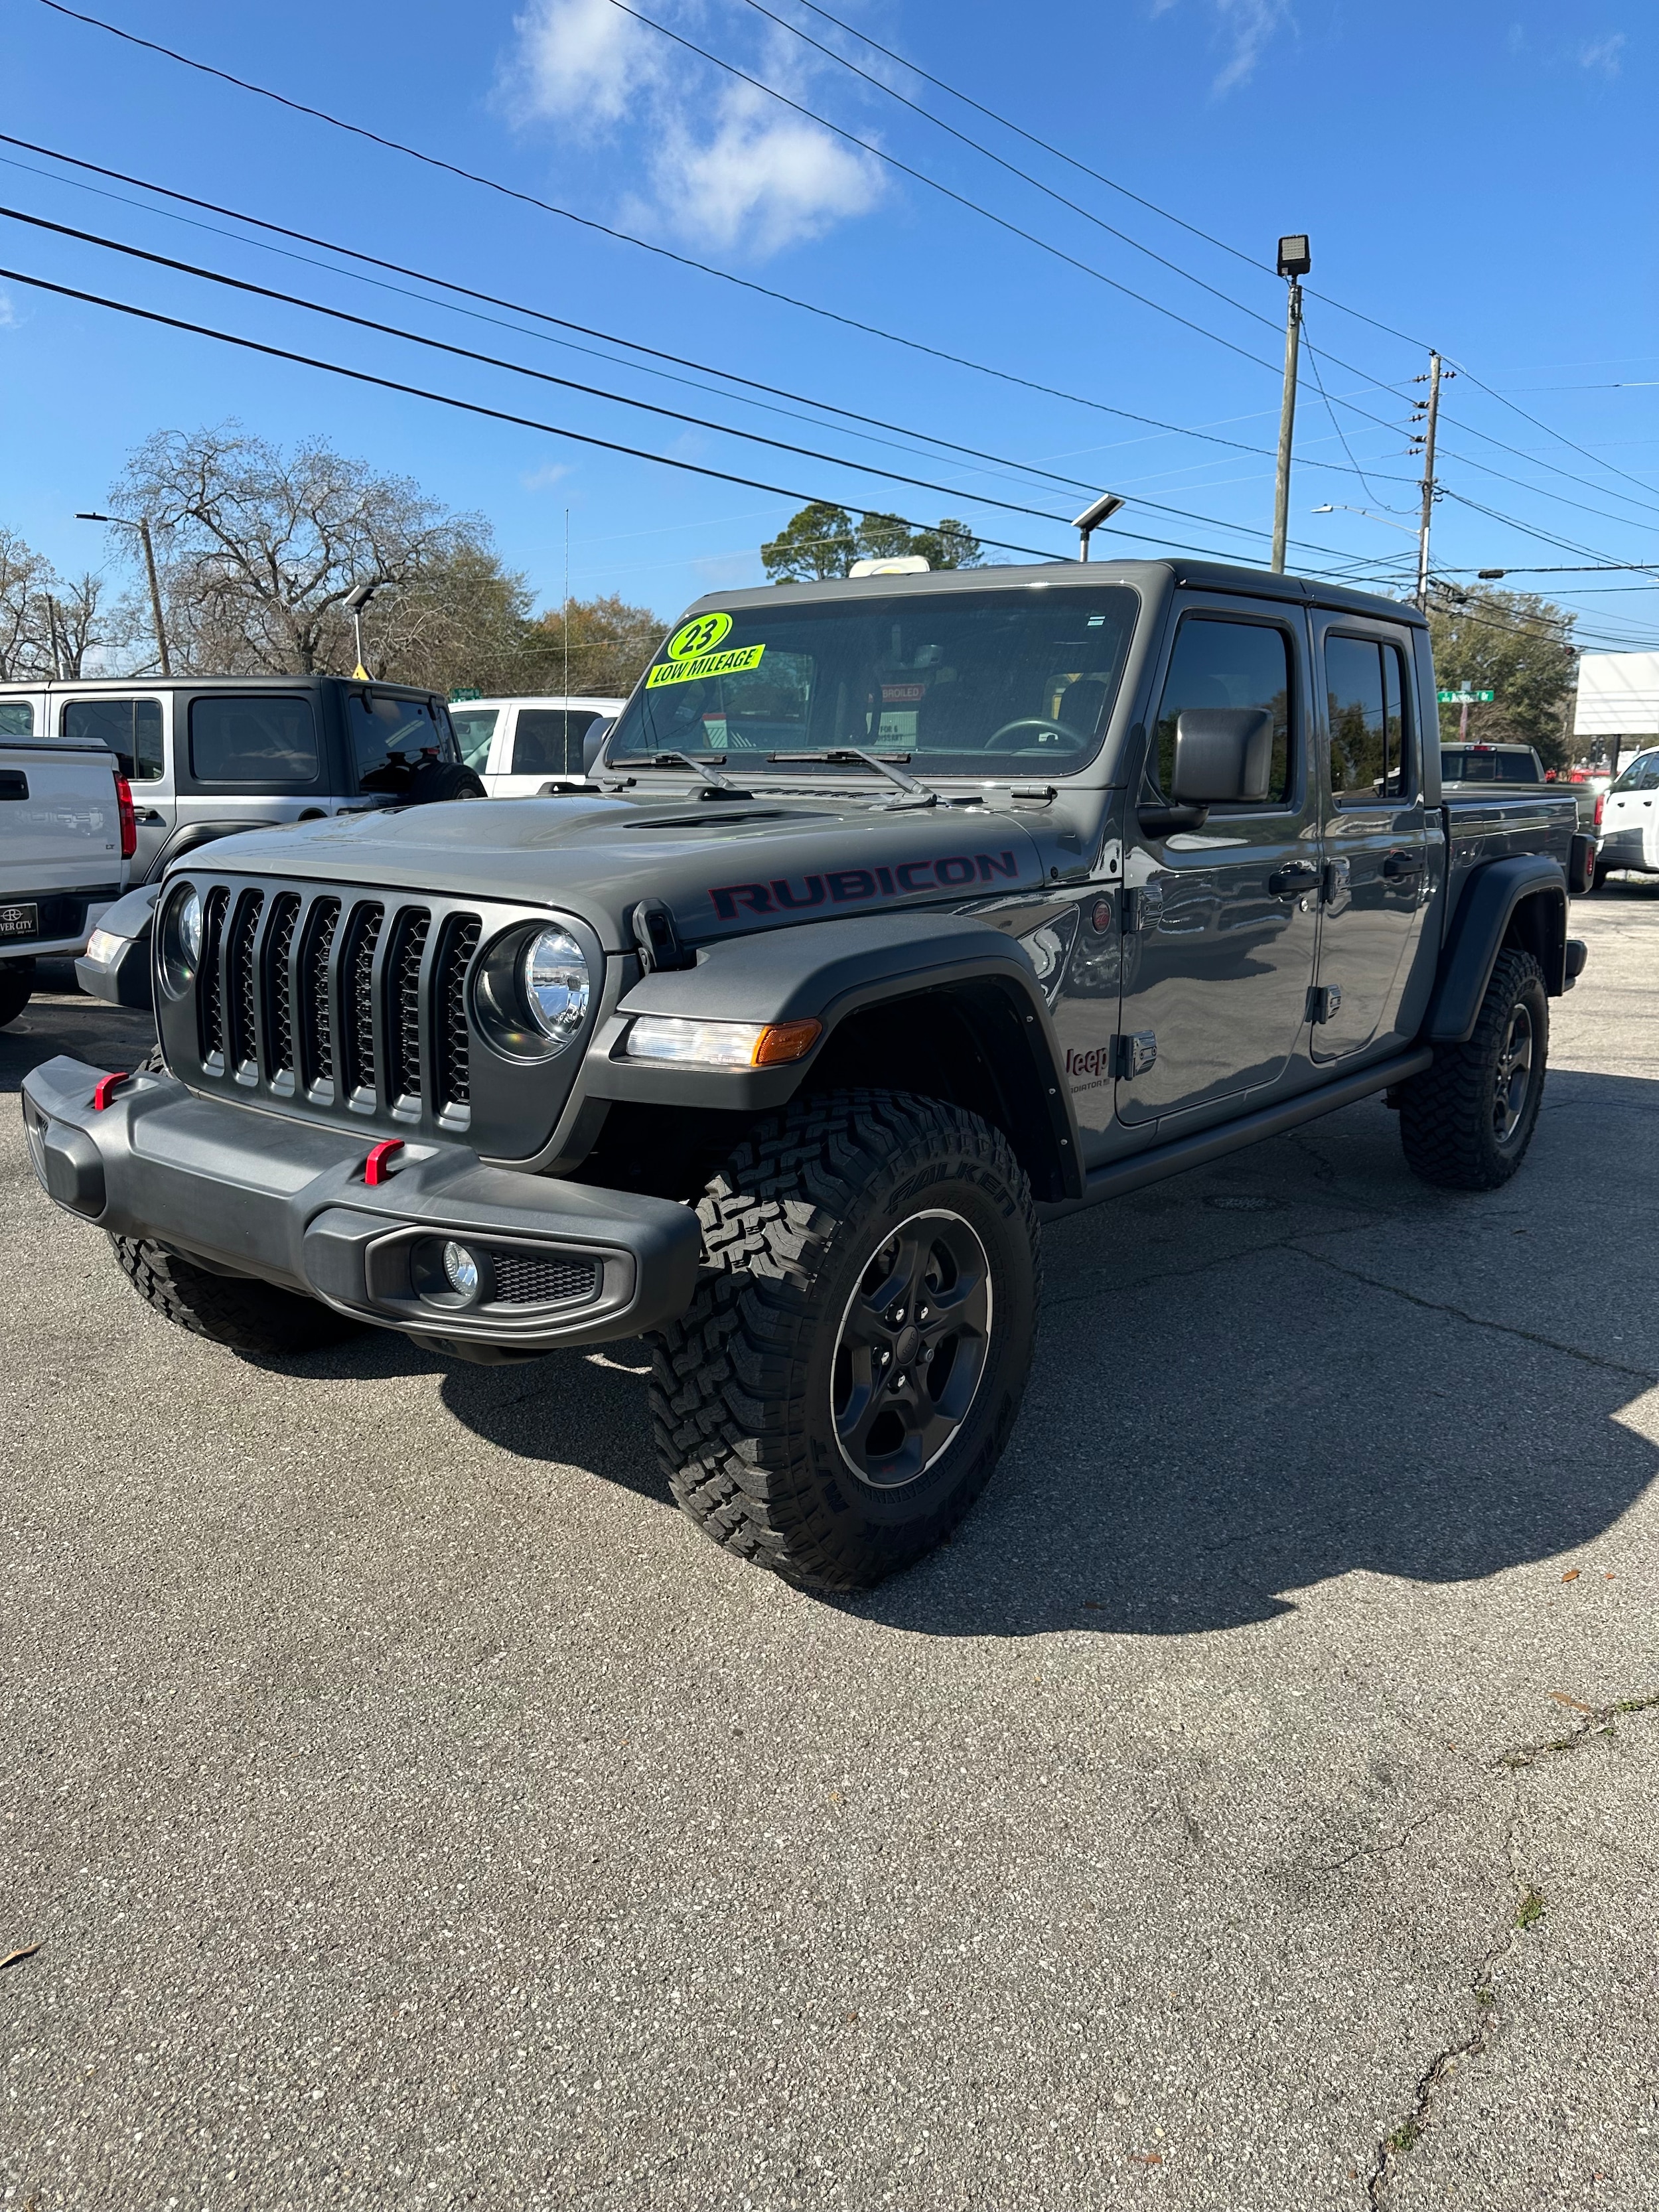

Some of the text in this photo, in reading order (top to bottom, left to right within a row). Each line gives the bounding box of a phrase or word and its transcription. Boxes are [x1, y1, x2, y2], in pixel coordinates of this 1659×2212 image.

[679, 619, 718, 655] 23
[652, 648, 758, 684] LOW MILEAGE
[883, 688, 920, 698] BROILED
[708, 851, 1019, 921] RUBICON
[16, 921, 32, 929] CITY
[1066, 1048, 1108, 1076] Jeep
